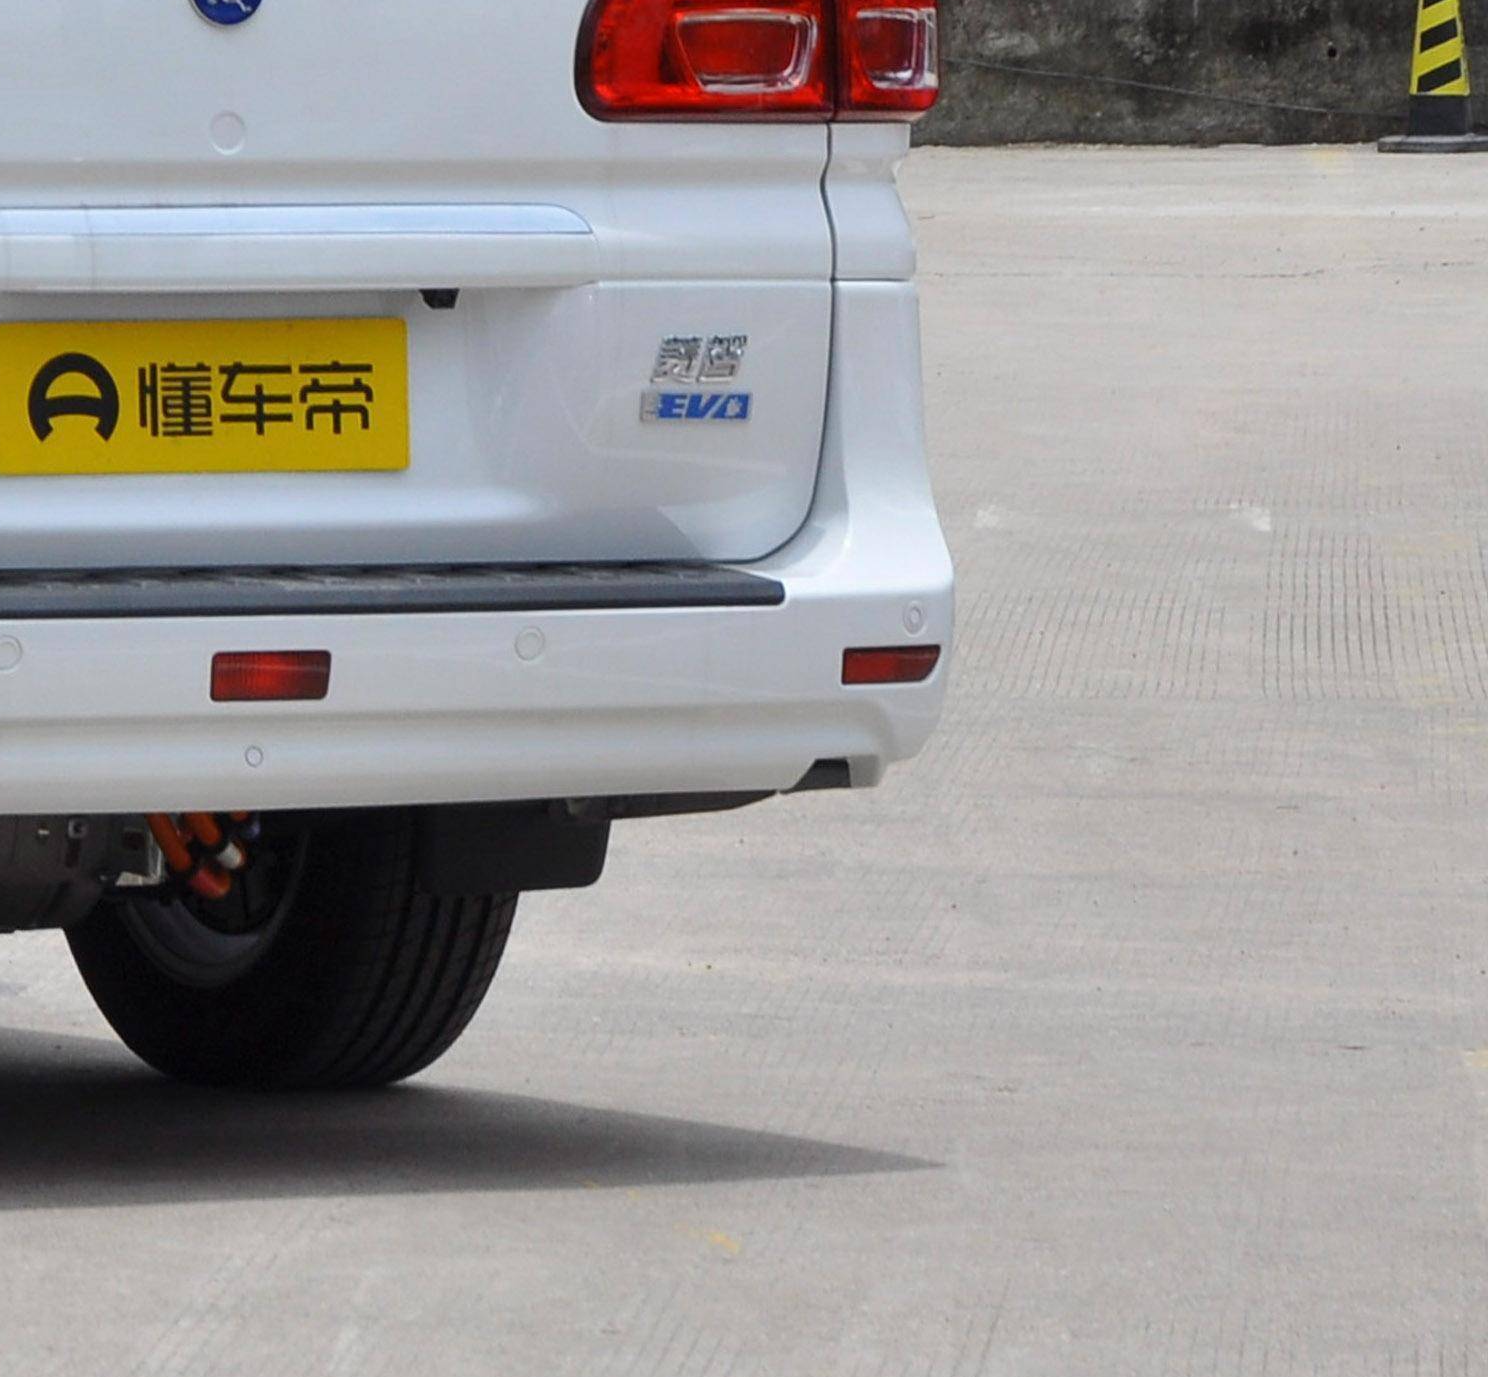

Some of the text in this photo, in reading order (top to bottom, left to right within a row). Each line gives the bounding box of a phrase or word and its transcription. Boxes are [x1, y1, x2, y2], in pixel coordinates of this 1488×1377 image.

[138, 361, 374, 437] 懂车帝
[658, 393, 750, 420] EVO
